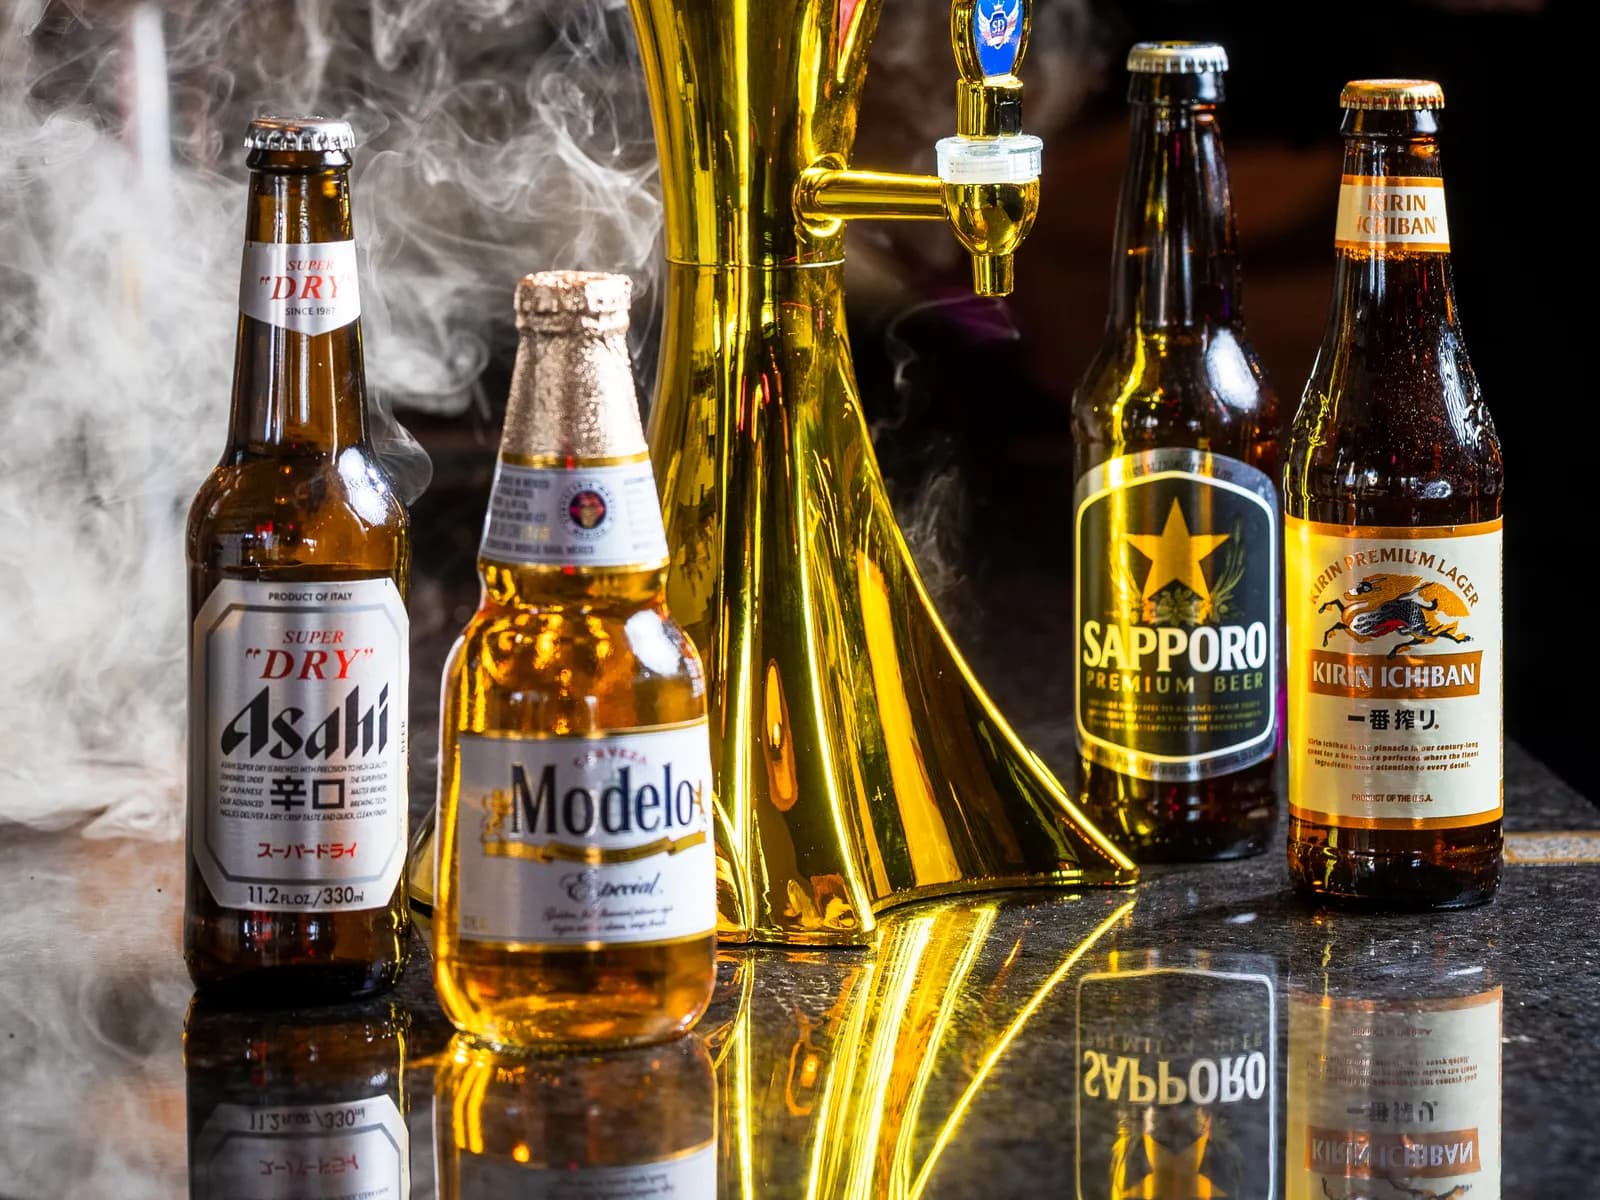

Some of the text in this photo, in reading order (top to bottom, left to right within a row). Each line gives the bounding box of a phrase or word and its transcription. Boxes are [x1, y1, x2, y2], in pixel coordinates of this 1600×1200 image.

[1367, 194, 1426, 212] KIRIN
[1356, 215, 1437, 235] ICHIBAN
[286, 260, 334, 272] SUPER
[259, 275, 348, 300] "DRY
[285, 307, 314, 316] SINCE
[1311, 547, 1480, 608] KIRIN PREMIUM LAGER
[268, 591, 353, 602] PRODUCT OF ITALY
[283, 630, 345, 645] SUPER
[1083, 620, 1267, 673] SAPPORO
[1086, 671, 1263, 694] PREMIUM BEER
[1312, 660, 1475, 689] KIRIN ICHIBAN
[220, 682, 389, 760] Asahi
[270, 775, 346, 811] 辛口
[511, 762, 695, 838] Modelo
[1351, 793, 1386, 802] PRODUCT
[1386, 794, 1396, 802] OF
[1397, 794, 1411, 802] THE
[257, 842, 357, 859] スーパードライ
